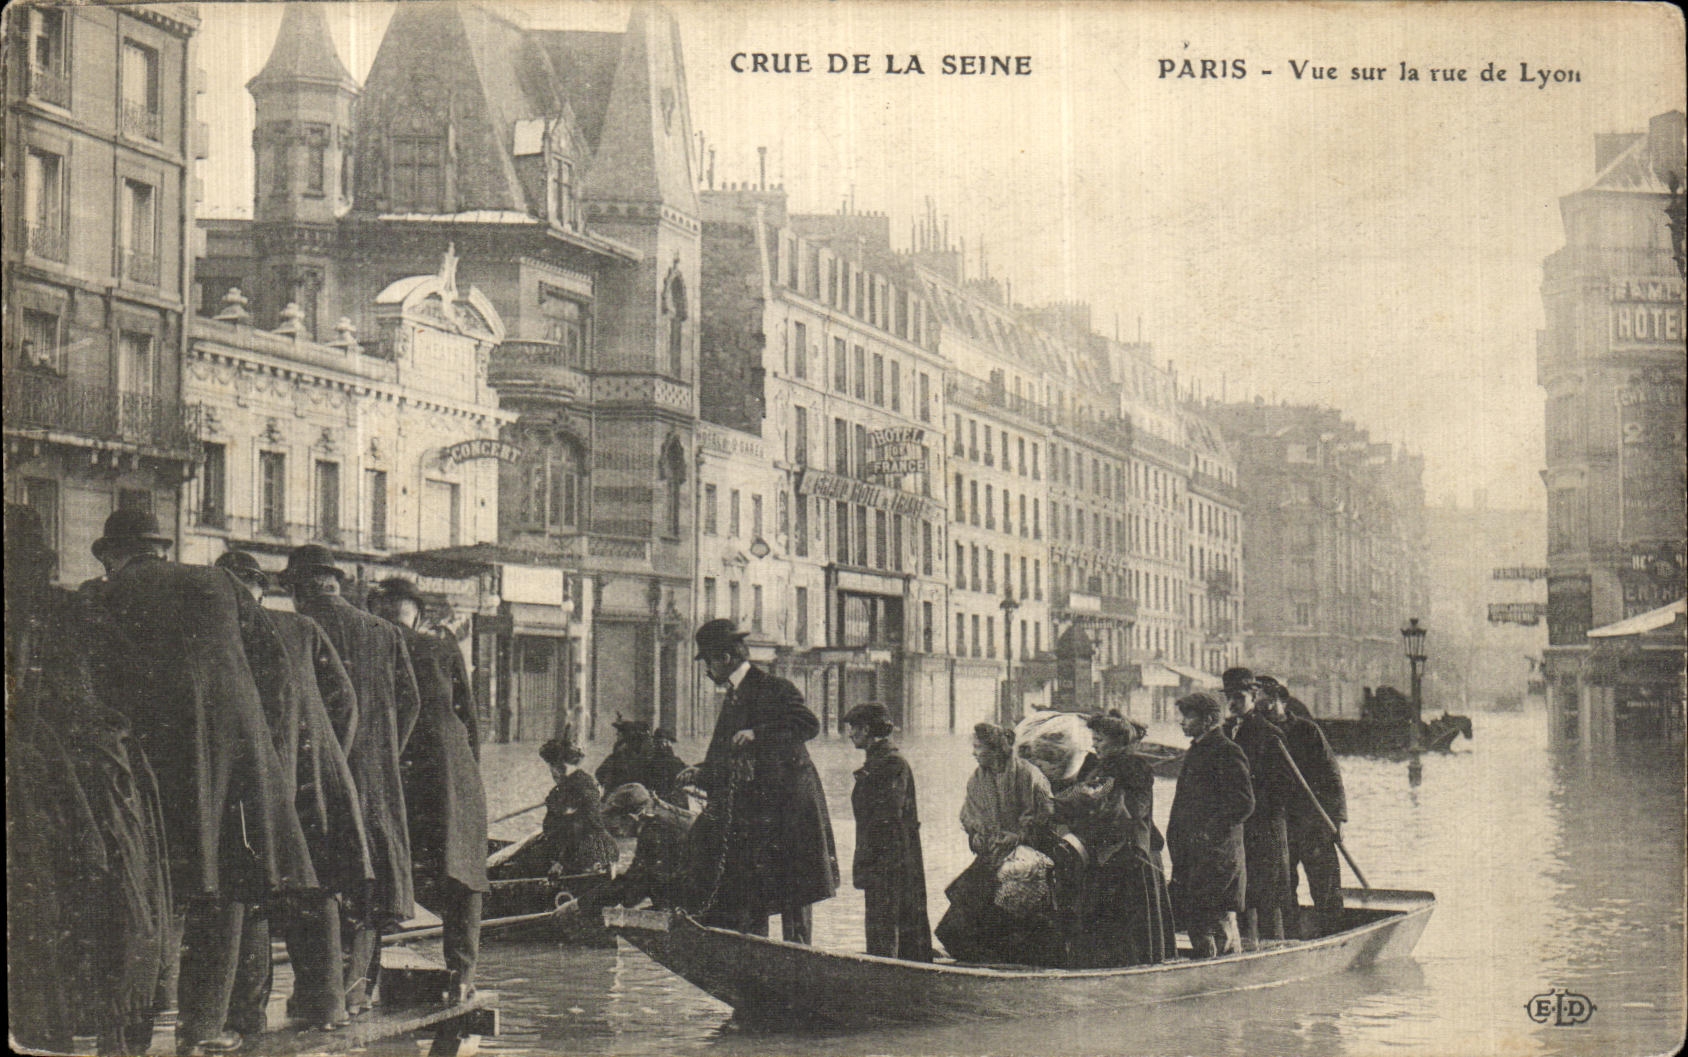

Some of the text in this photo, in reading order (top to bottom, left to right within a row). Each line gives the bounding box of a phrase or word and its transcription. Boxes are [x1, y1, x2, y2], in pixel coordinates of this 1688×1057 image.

[872, 427, 922, 446] HOTEL
[451, 440, 521, 464] CONCERT
[872, 460, 927, 474] FRANCE
